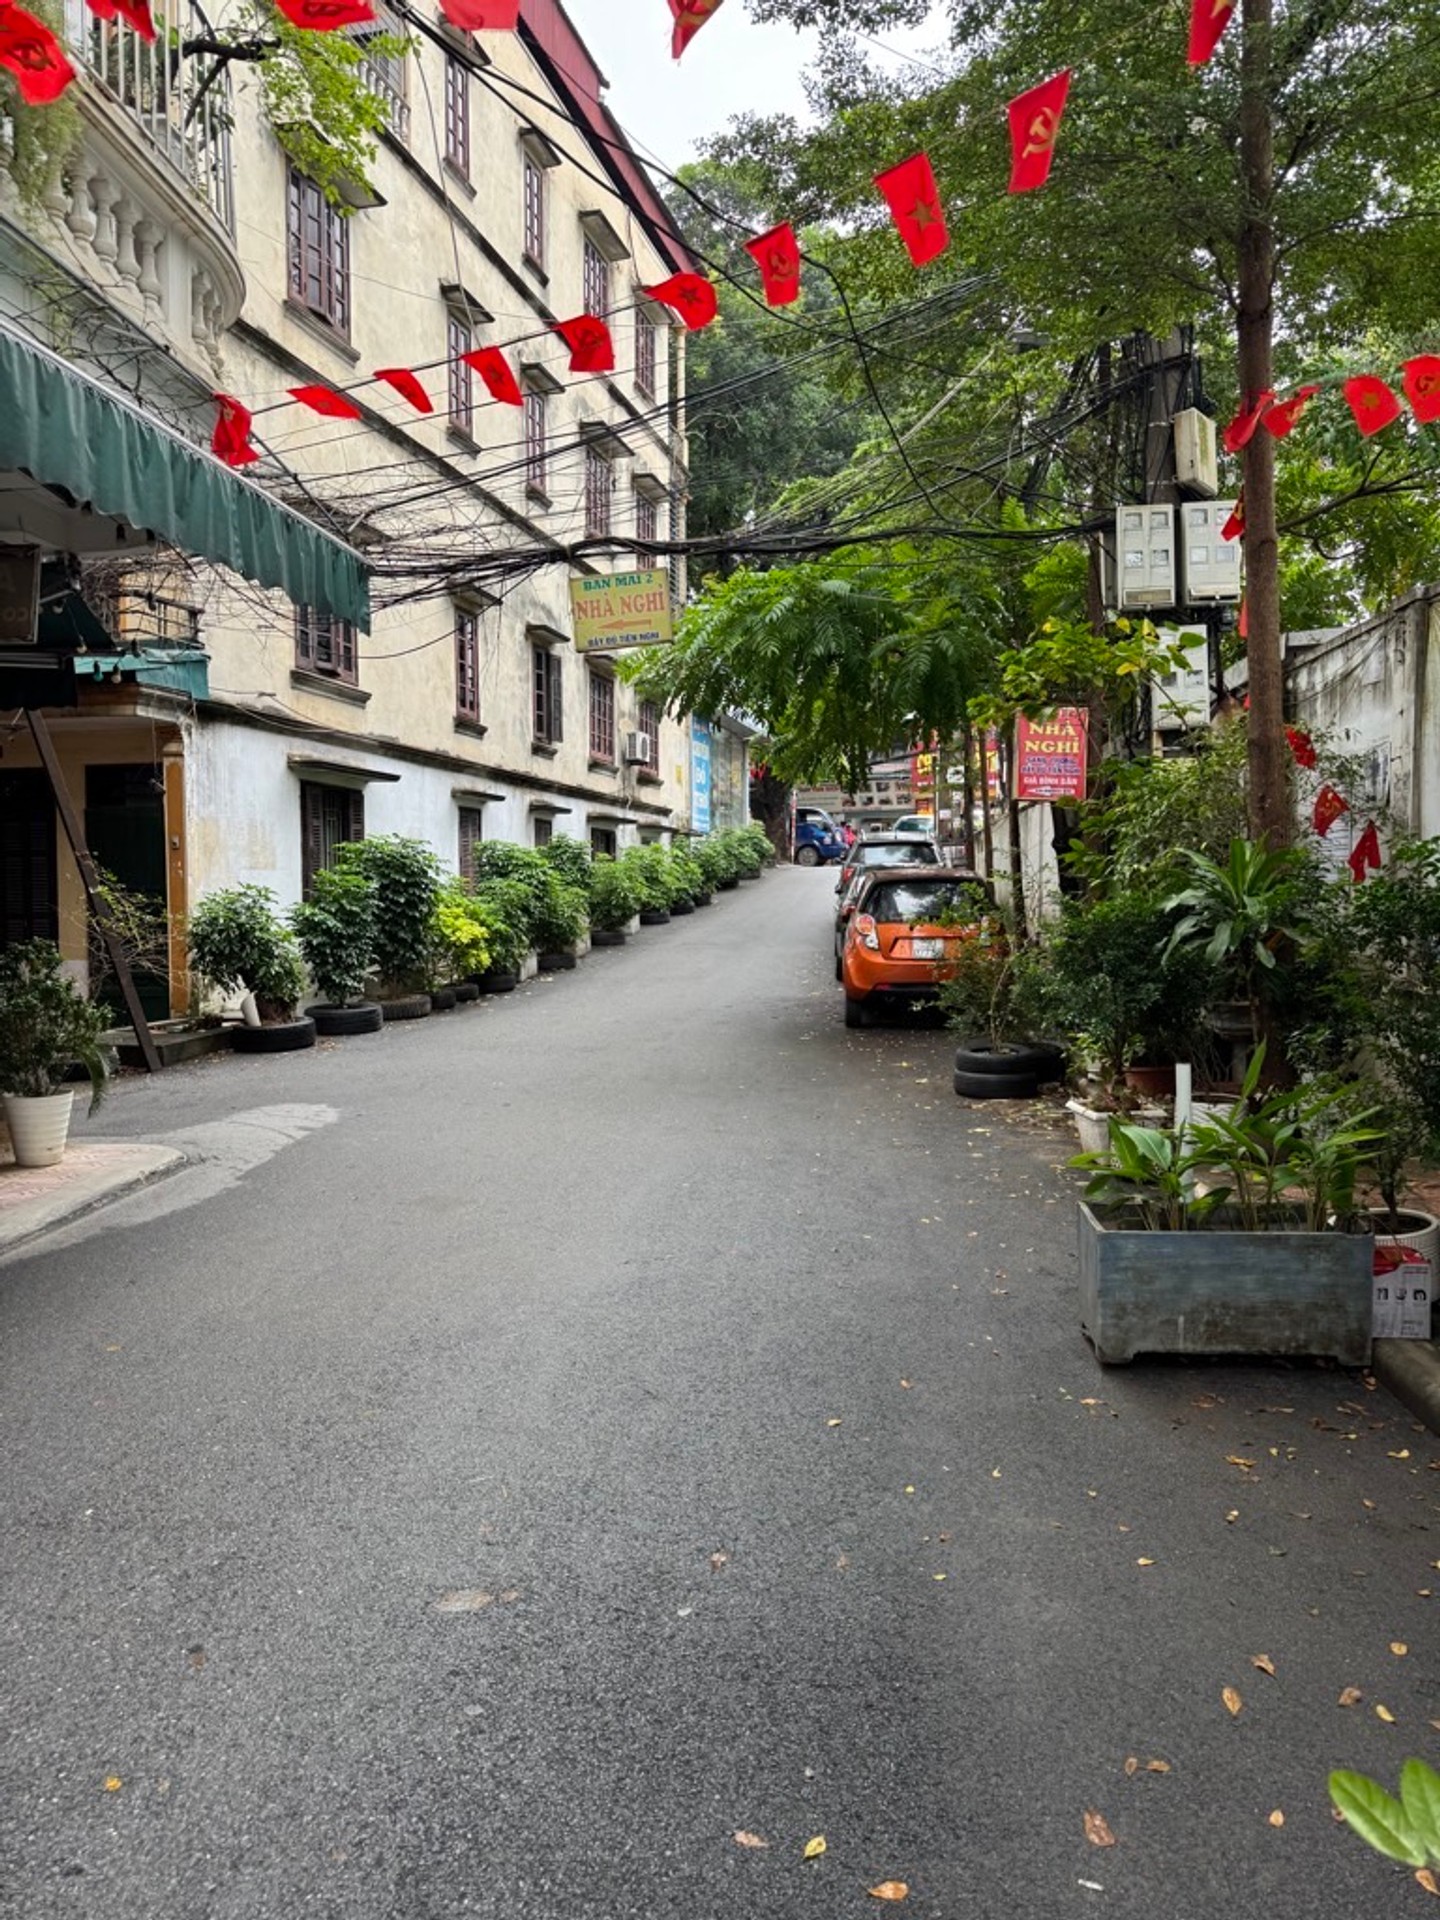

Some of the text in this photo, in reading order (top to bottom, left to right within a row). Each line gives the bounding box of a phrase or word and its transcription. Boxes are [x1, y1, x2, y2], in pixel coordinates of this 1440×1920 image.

[583, 573, 653, 590] BAN MAI 2
[576, 584, 665, 619] NHÀ NGHỈ
[1029, 720, 1076, 735] NHÀ
[1025, 737, 1079, 753] NGHỈ
